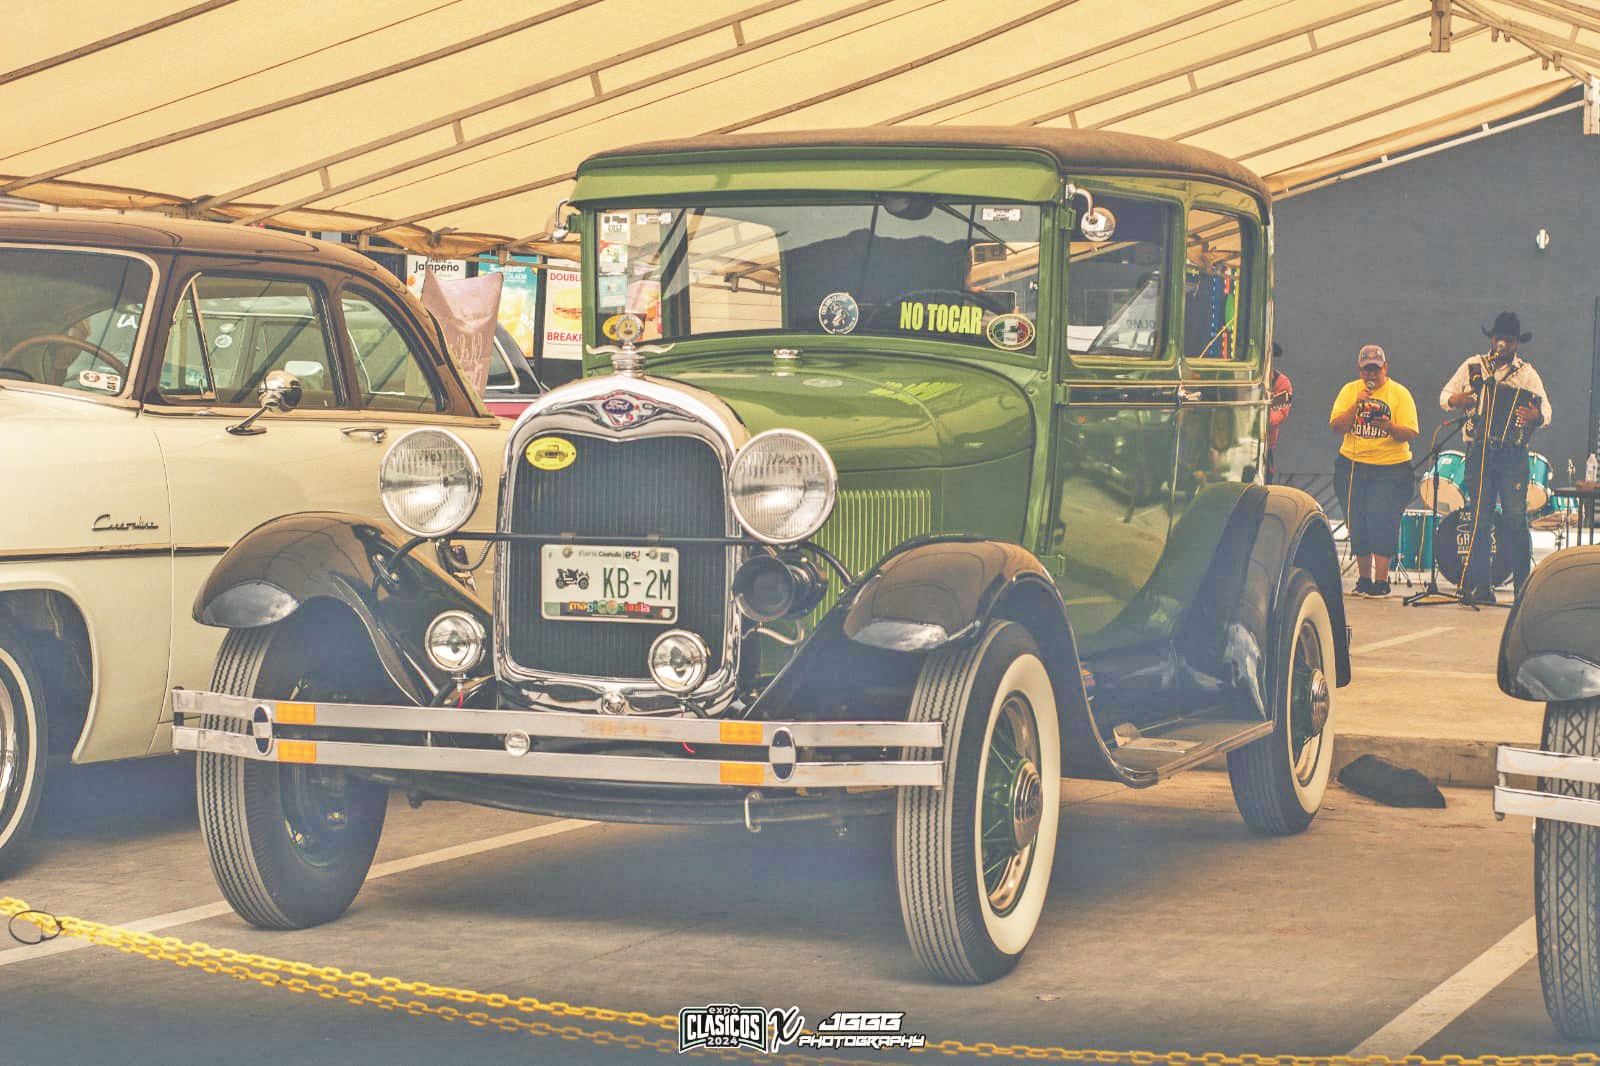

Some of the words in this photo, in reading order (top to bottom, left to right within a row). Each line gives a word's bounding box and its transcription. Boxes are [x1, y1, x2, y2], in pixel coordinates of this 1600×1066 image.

[901, 301, 923, 331] NO
[927, 303, 983, 335] TOCAR
[603, 567, 671, 600] KB-2M
